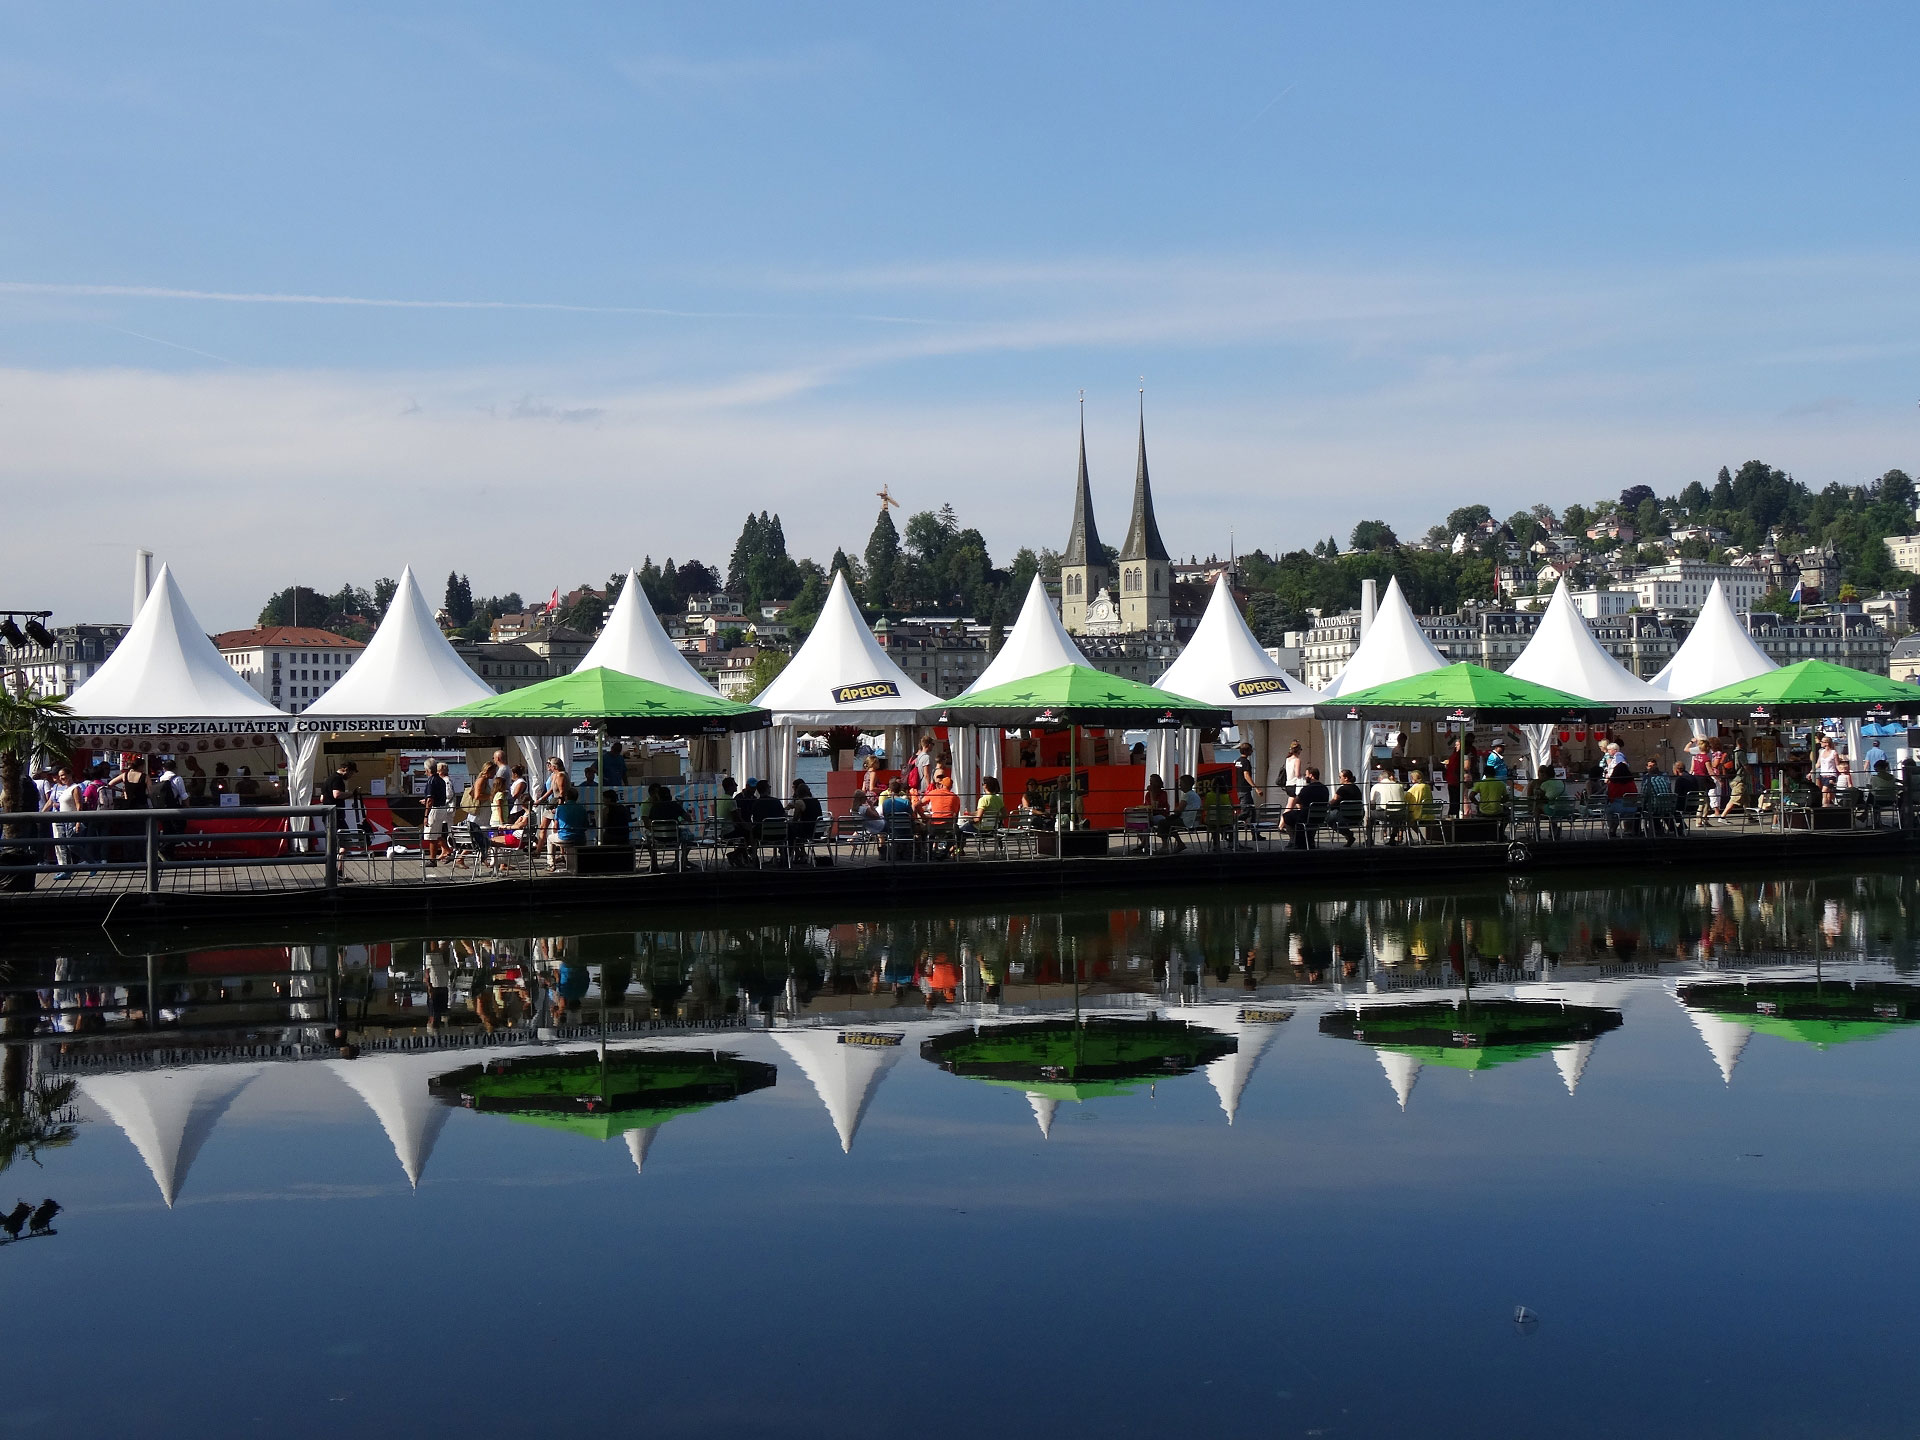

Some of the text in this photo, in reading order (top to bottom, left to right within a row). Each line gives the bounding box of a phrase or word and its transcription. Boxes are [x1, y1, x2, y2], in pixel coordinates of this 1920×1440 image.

[1314, 616, 1351, 628] NATIONAL
[1422, 616, 1459, 627] HOTEL
[840, 685, 896, 700] APEROL
[1238, 681, 1286, 695] APEROL
[1632, 706, 1654, 715] ASIA
[157, 720, 289, 734] SPEZIALITÄTEN
[297, 720, 394, 732] CONFISERIE
